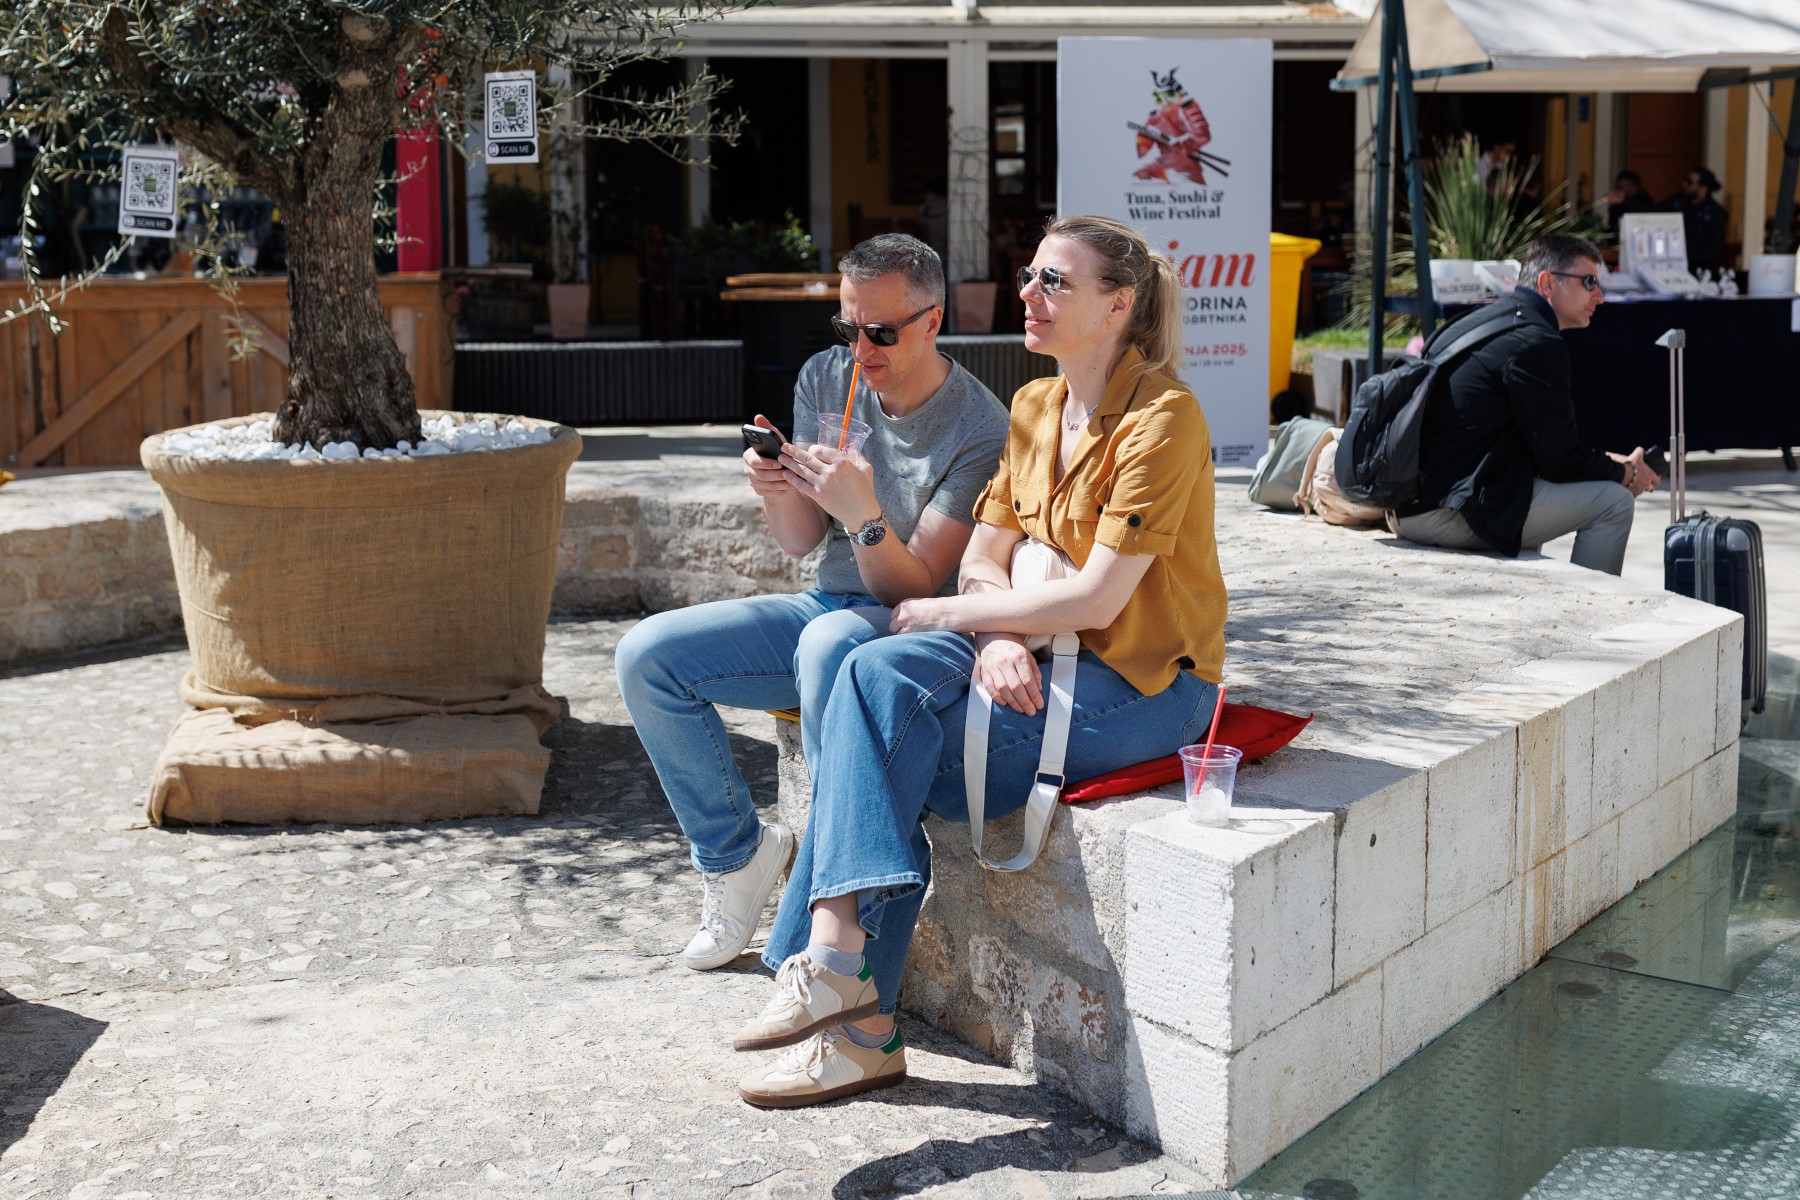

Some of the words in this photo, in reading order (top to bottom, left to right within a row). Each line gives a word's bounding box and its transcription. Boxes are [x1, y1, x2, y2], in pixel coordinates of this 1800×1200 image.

[500, 145, 518, 155] SCAN
[519, 144, 530, 154] ME
[1124, 191, 1166, 205] Tuna,
[1169, 189, 1207, 204] Sushi
[1211, 190, 1224, 203] &
[1129, 206, 1164, 219] Wine
[1169, 205, 1220, 219] Festival
[1183, 314, 1246, 325] OBRTNIKA
[1213, 343, 1246, 357] 2025
